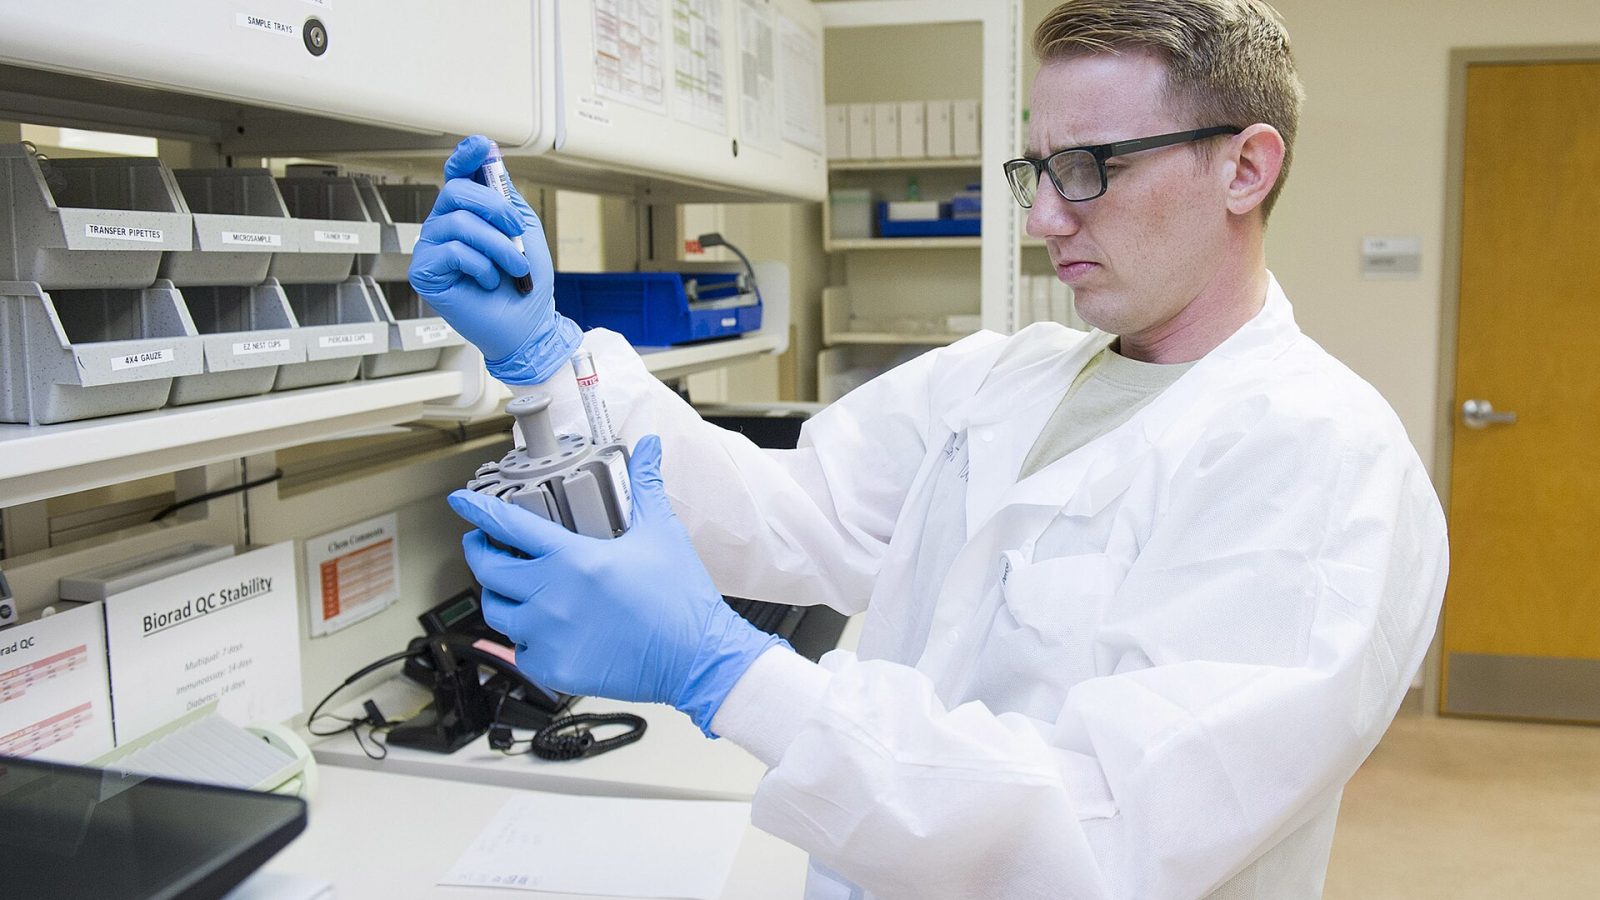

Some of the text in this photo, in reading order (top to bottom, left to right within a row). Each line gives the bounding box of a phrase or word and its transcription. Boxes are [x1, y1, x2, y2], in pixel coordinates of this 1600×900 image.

[247, 16, 293, 34] SAMPLE TRAYS
[89, 225, 161, 239] TRANSFER PIPETTES
[232, 233, 272, 243] MICROSAMPLE
[252, 342, 266, 350] NEST
[124, 351, 163, 364] 4X4 GAUZE
[143, 577, 273, 632] Biorad QC Stability
[20, 636, 35, 649] QC
